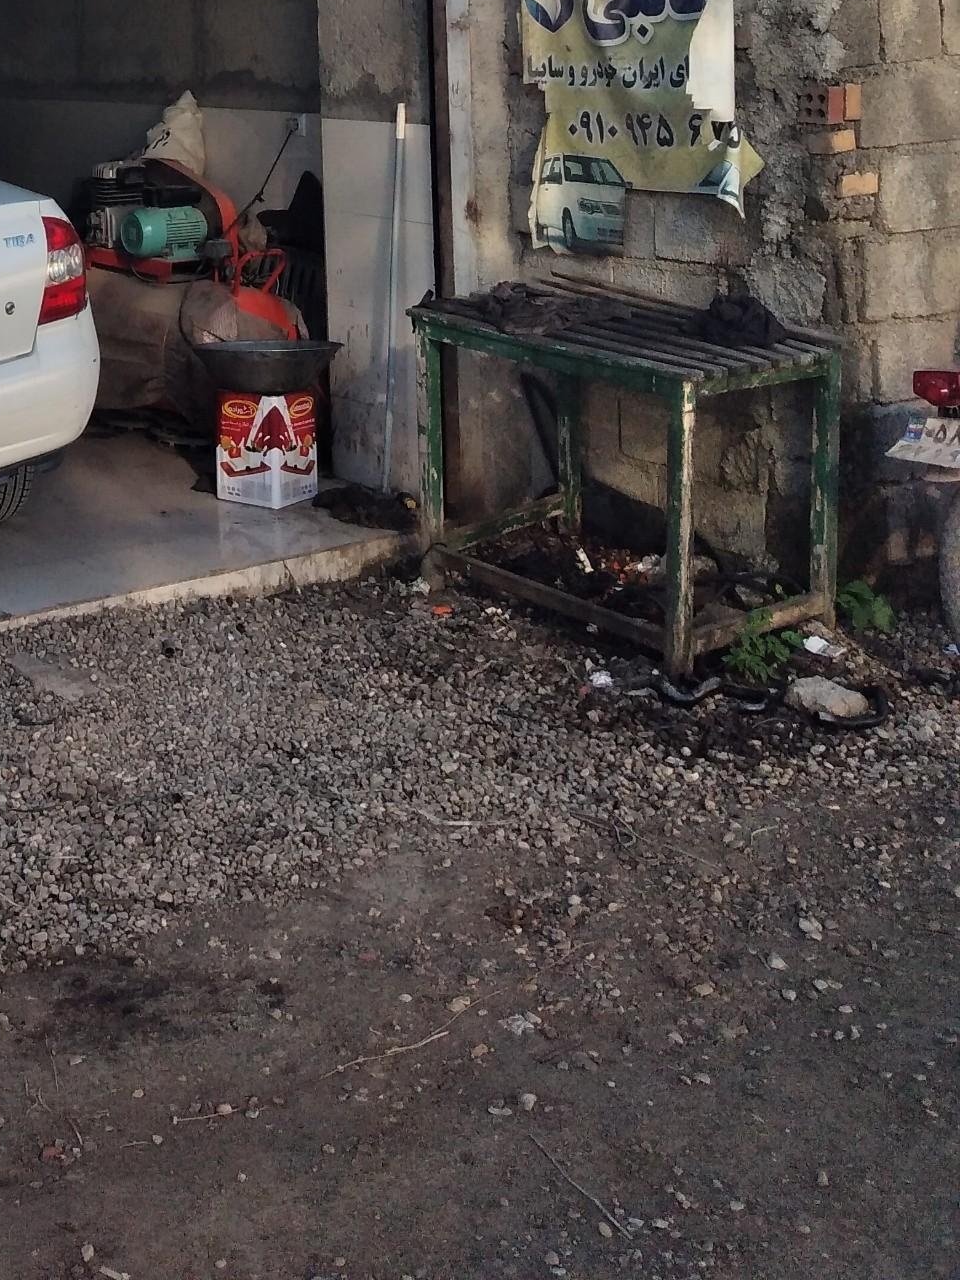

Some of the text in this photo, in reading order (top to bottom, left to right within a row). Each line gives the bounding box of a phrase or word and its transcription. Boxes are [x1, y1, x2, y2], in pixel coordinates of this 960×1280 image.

[568, 65, 575, 86] و
[622, 56, 665, 89] ایران
[568, 111, 618, 144] ۰۹۱۰
